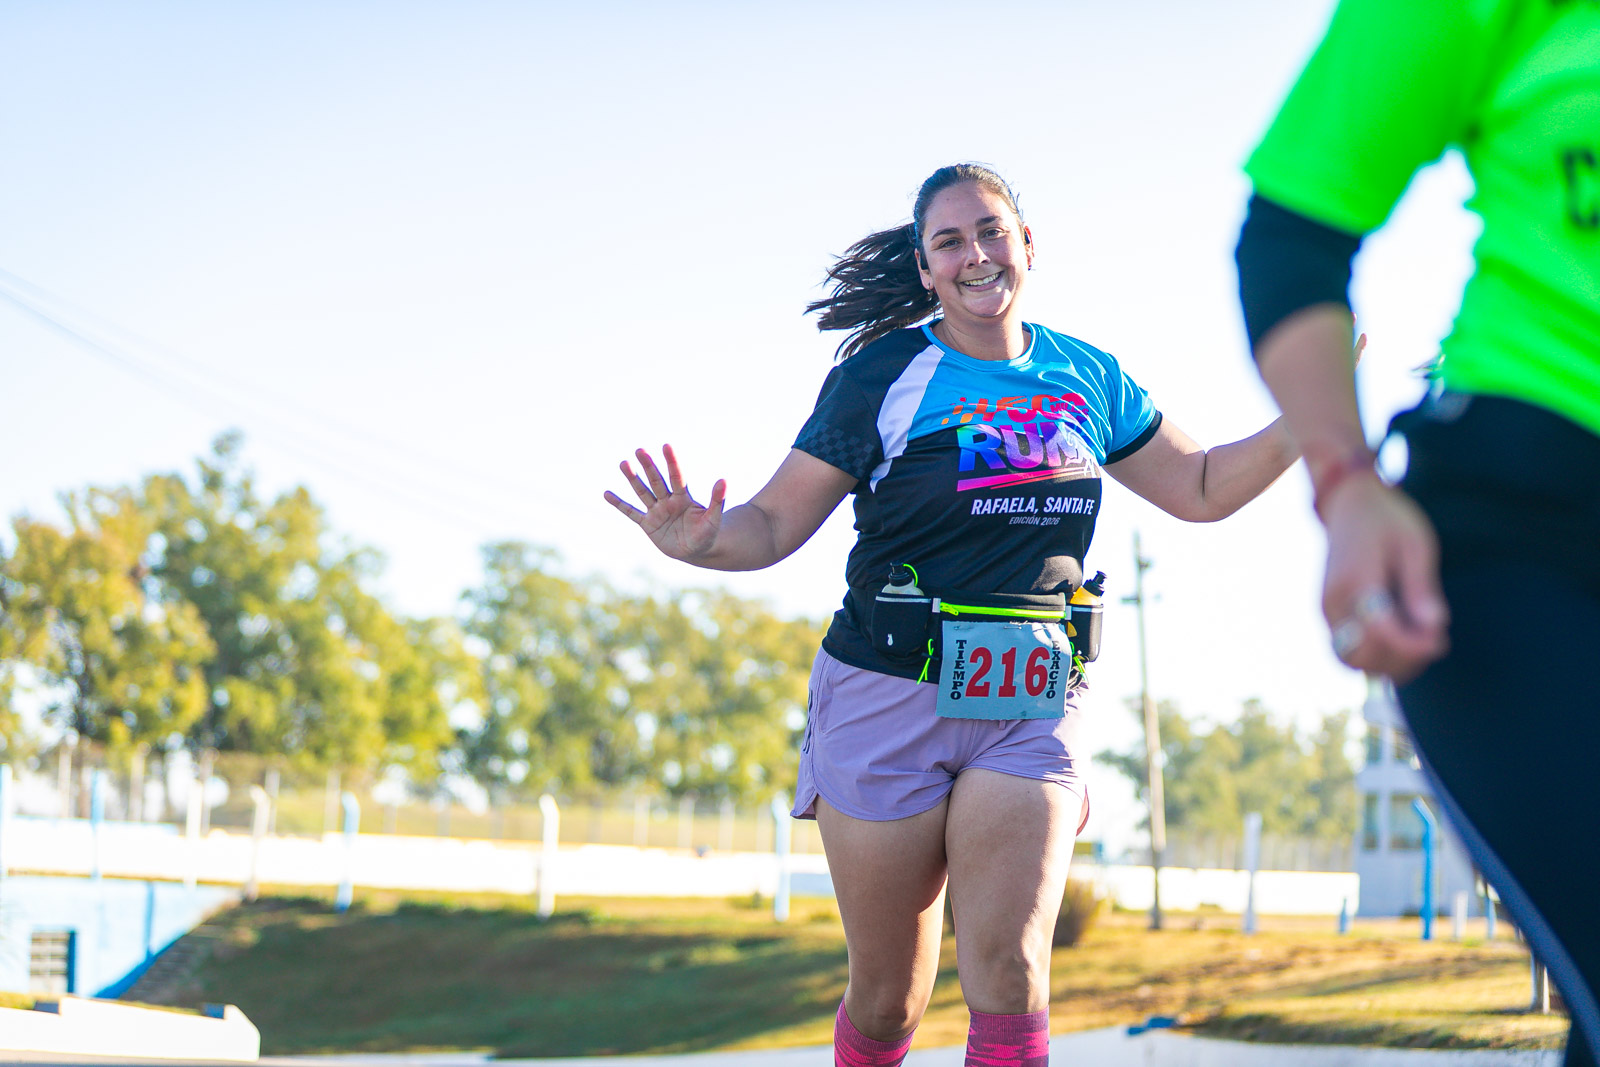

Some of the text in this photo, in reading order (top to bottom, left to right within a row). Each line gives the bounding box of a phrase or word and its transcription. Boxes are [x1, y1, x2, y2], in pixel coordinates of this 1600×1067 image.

[971, 497, 1095, 515] RAFAELA, SANTA FE
[1009, 515, 1060, 526] EDICIÓN 2026
[950, 639, 967, 700] TIEMPO
[965, 647, 1050, 697] 216
[1046, 640, 1061, 699] EXACTO
